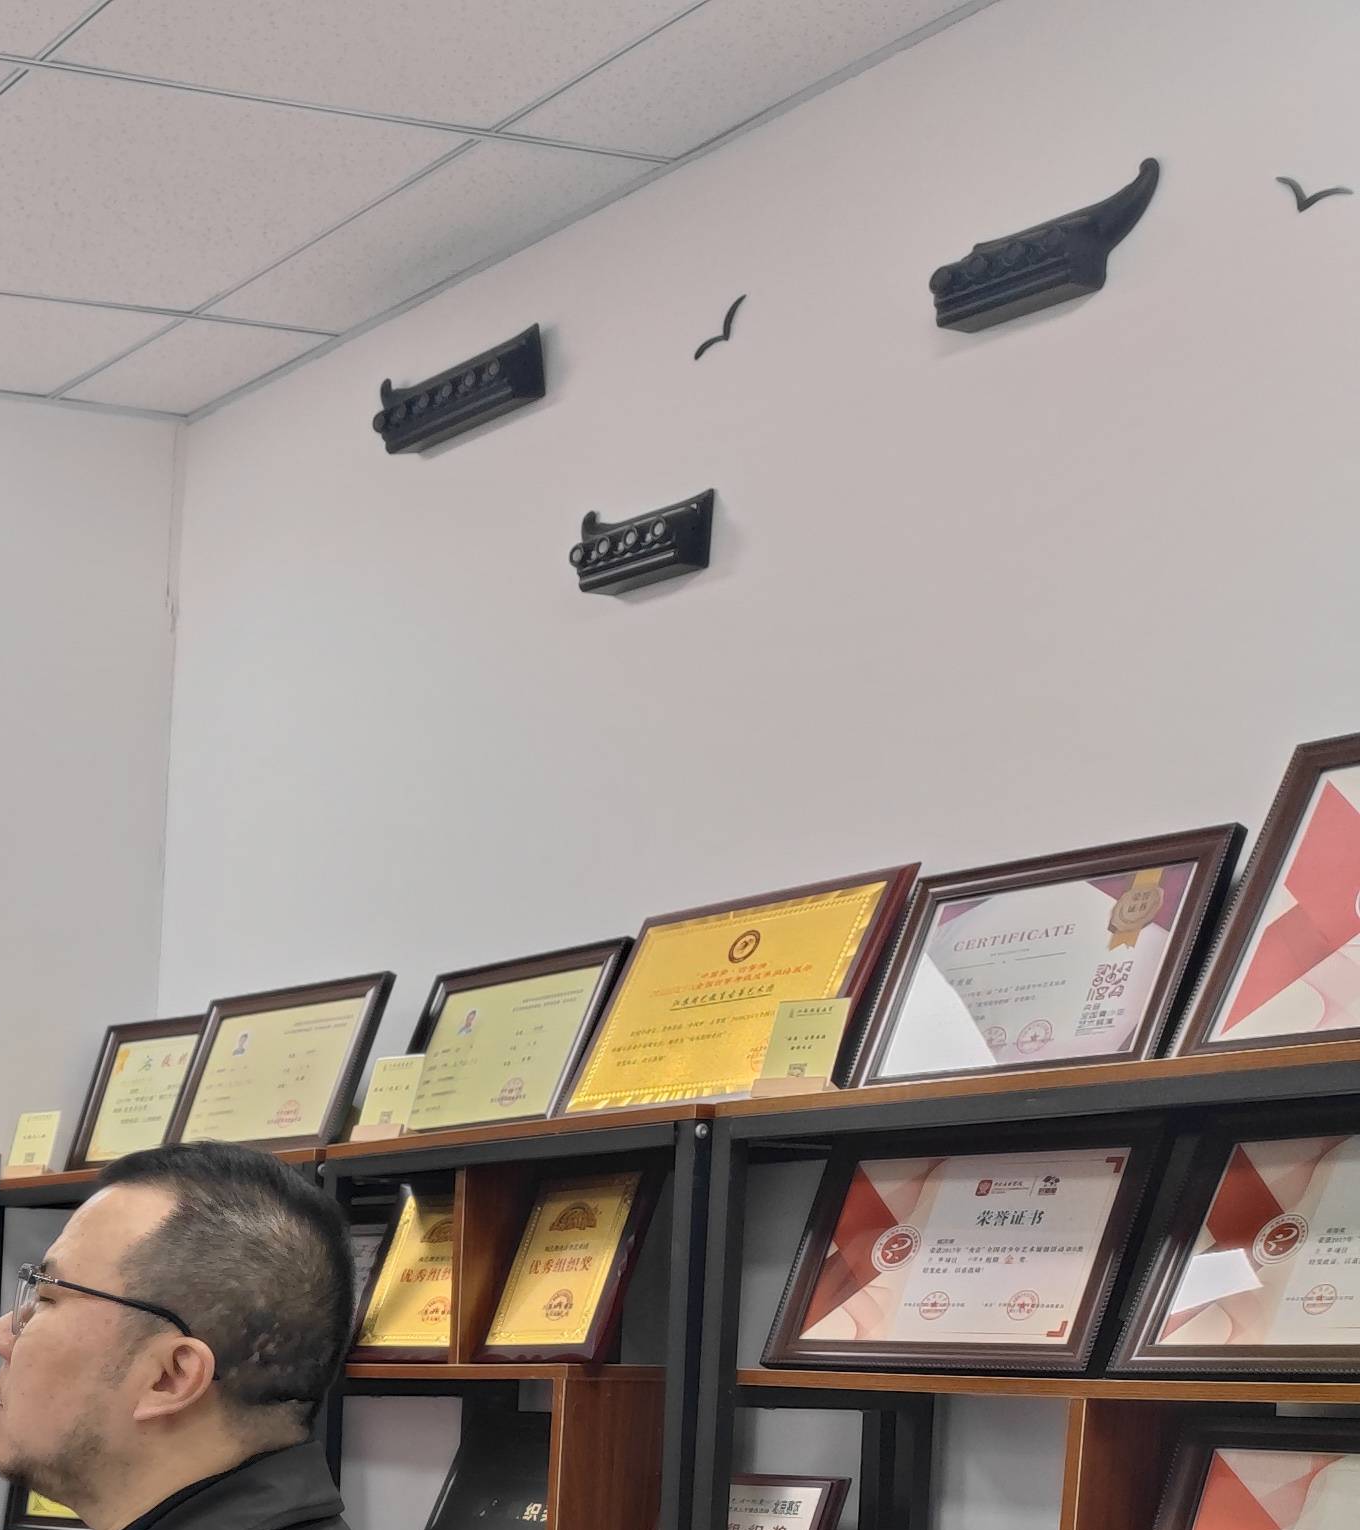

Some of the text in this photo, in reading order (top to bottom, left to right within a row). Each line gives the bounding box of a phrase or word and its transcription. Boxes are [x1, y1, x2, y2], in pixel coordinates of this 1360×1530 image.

[953, 923, 1077, 952] CERTIFICATE
[976, 1209, 1045, 1227] 荣誉证书
[529, 1256, 593, 1275] 优秀组织奖
